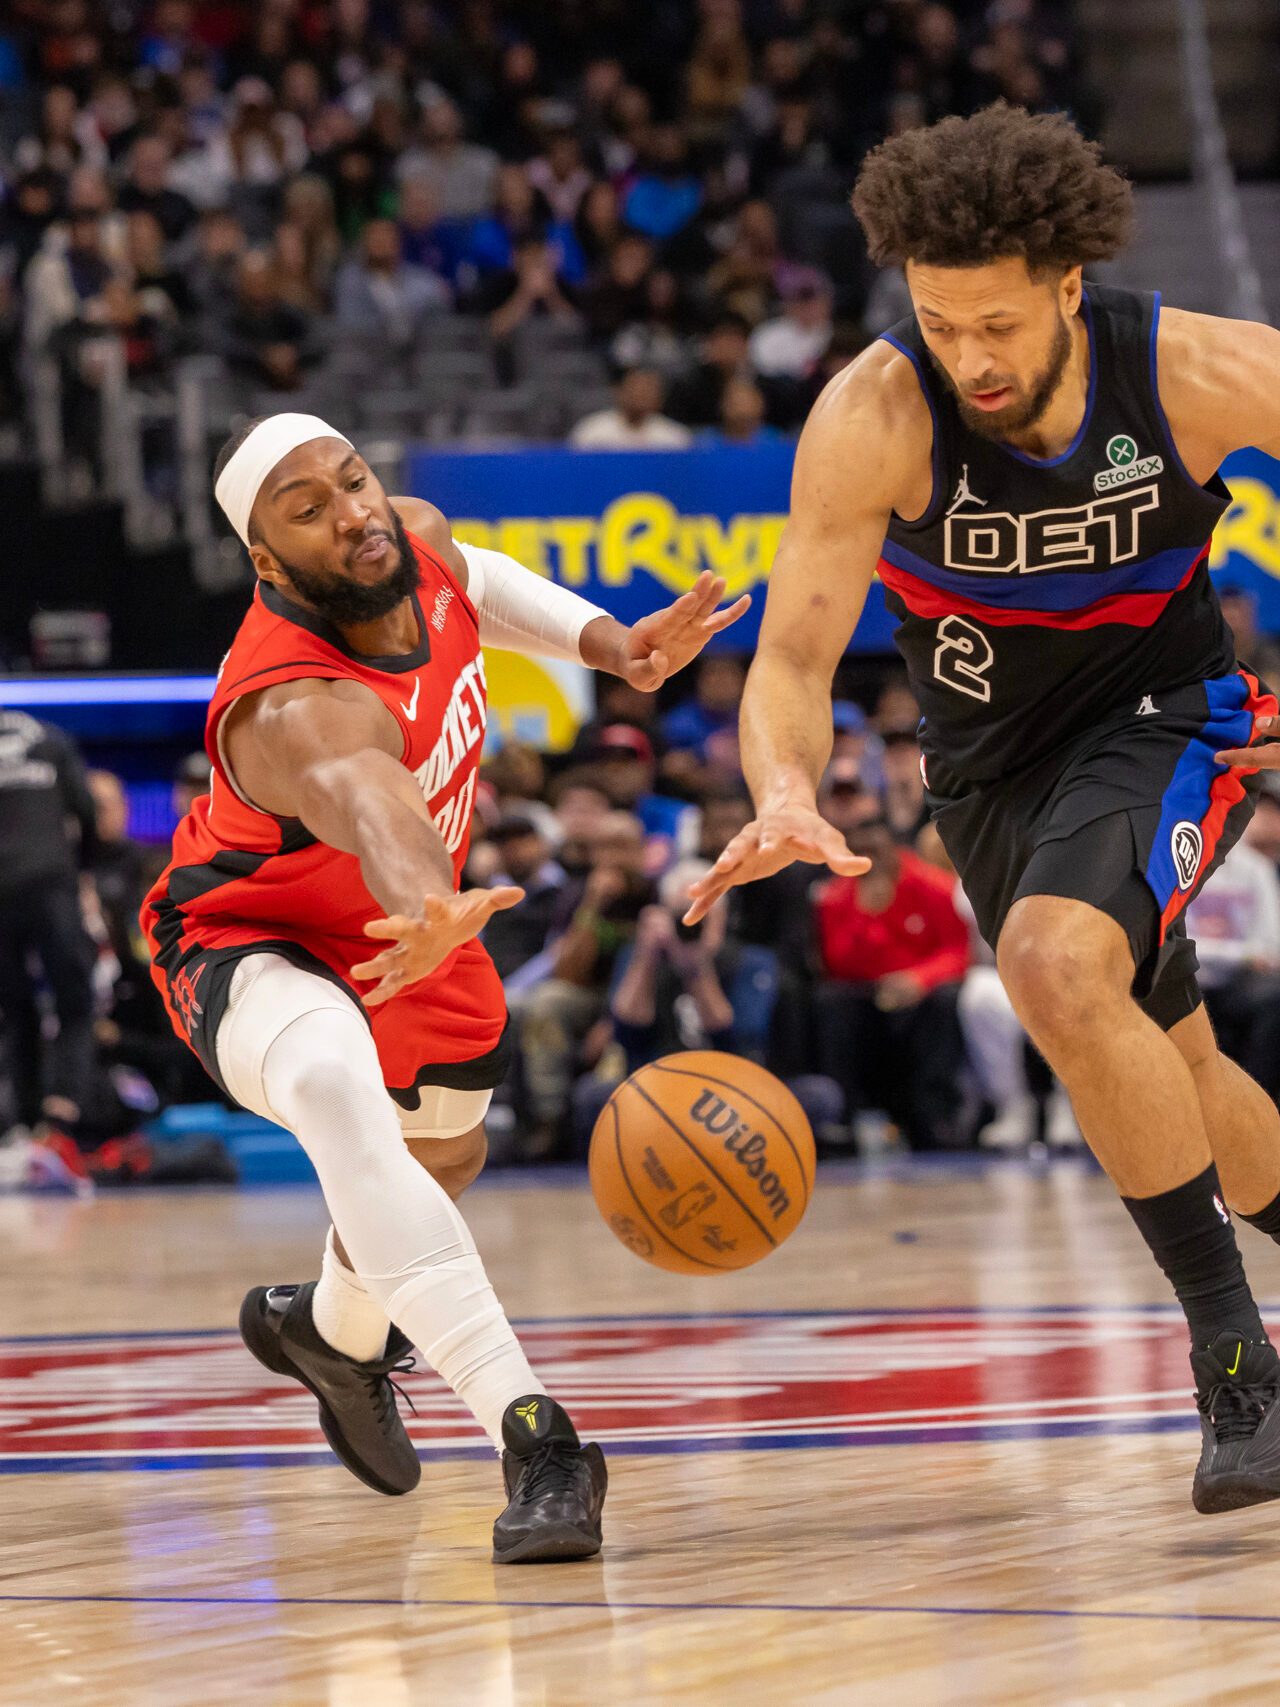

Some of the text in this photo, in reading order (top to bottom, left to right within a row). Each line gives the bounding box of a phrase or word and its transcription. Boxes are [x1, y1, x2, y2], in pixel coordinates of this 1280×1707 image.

[1097, 458, 1161, 488] StockX
[944, 483, 1160, 574] DET
[933, 614, 994, 704] 2
[689, 1087, 791, 1222] Wilson
